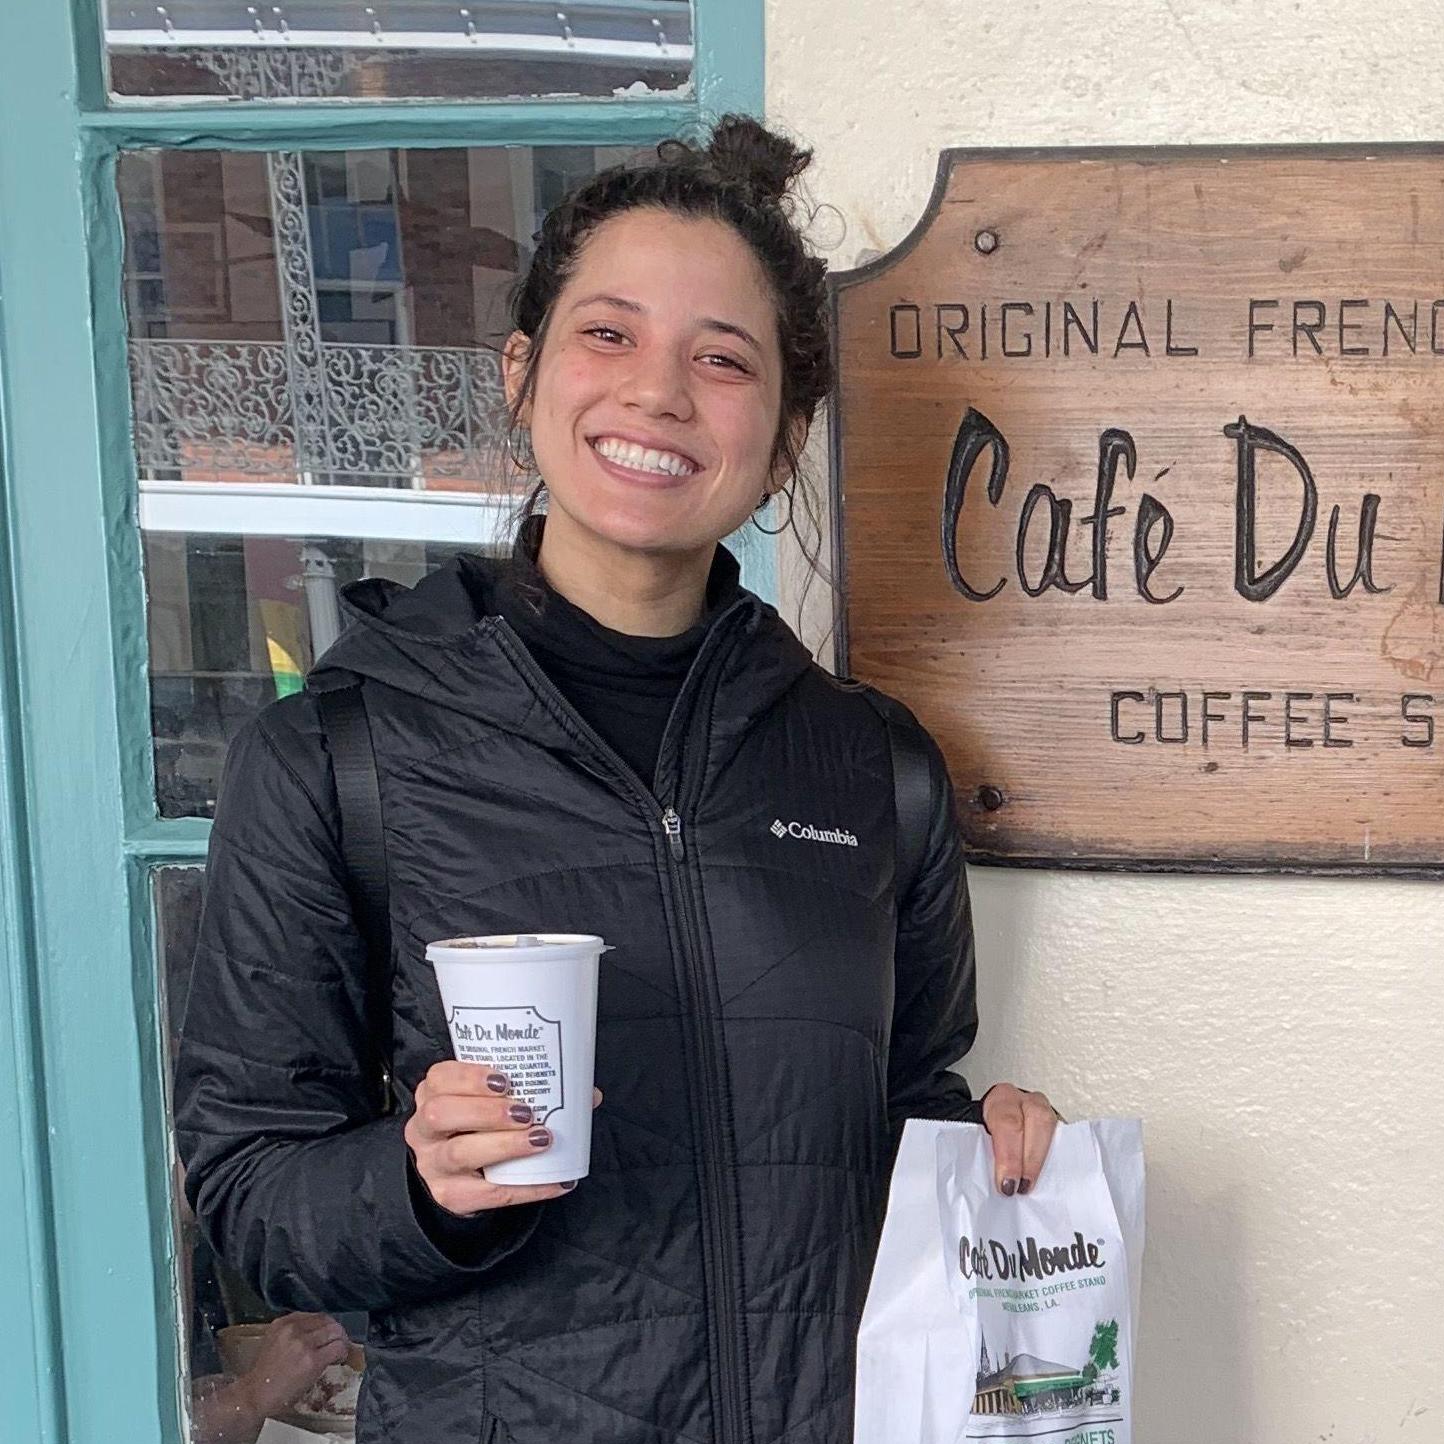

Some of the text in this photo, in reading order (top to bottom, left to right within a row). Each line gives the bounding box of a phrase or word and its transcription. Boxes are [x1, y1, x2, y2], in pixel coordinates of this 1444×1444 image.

[890, 299, 1199, 361] ORIGINAL
[941, 406, 1185, 602] Café
[1223, 414, 1397, 602] Du
[1110, 691, 1356, 752] COFFEE
[788, 822, 858, 847] Columbia
[474, 1024, 494, 1041] Du
[1042, 1280, 1078, 1297] COFFEE
[1078, 1275, 1106, 1290] STAND
